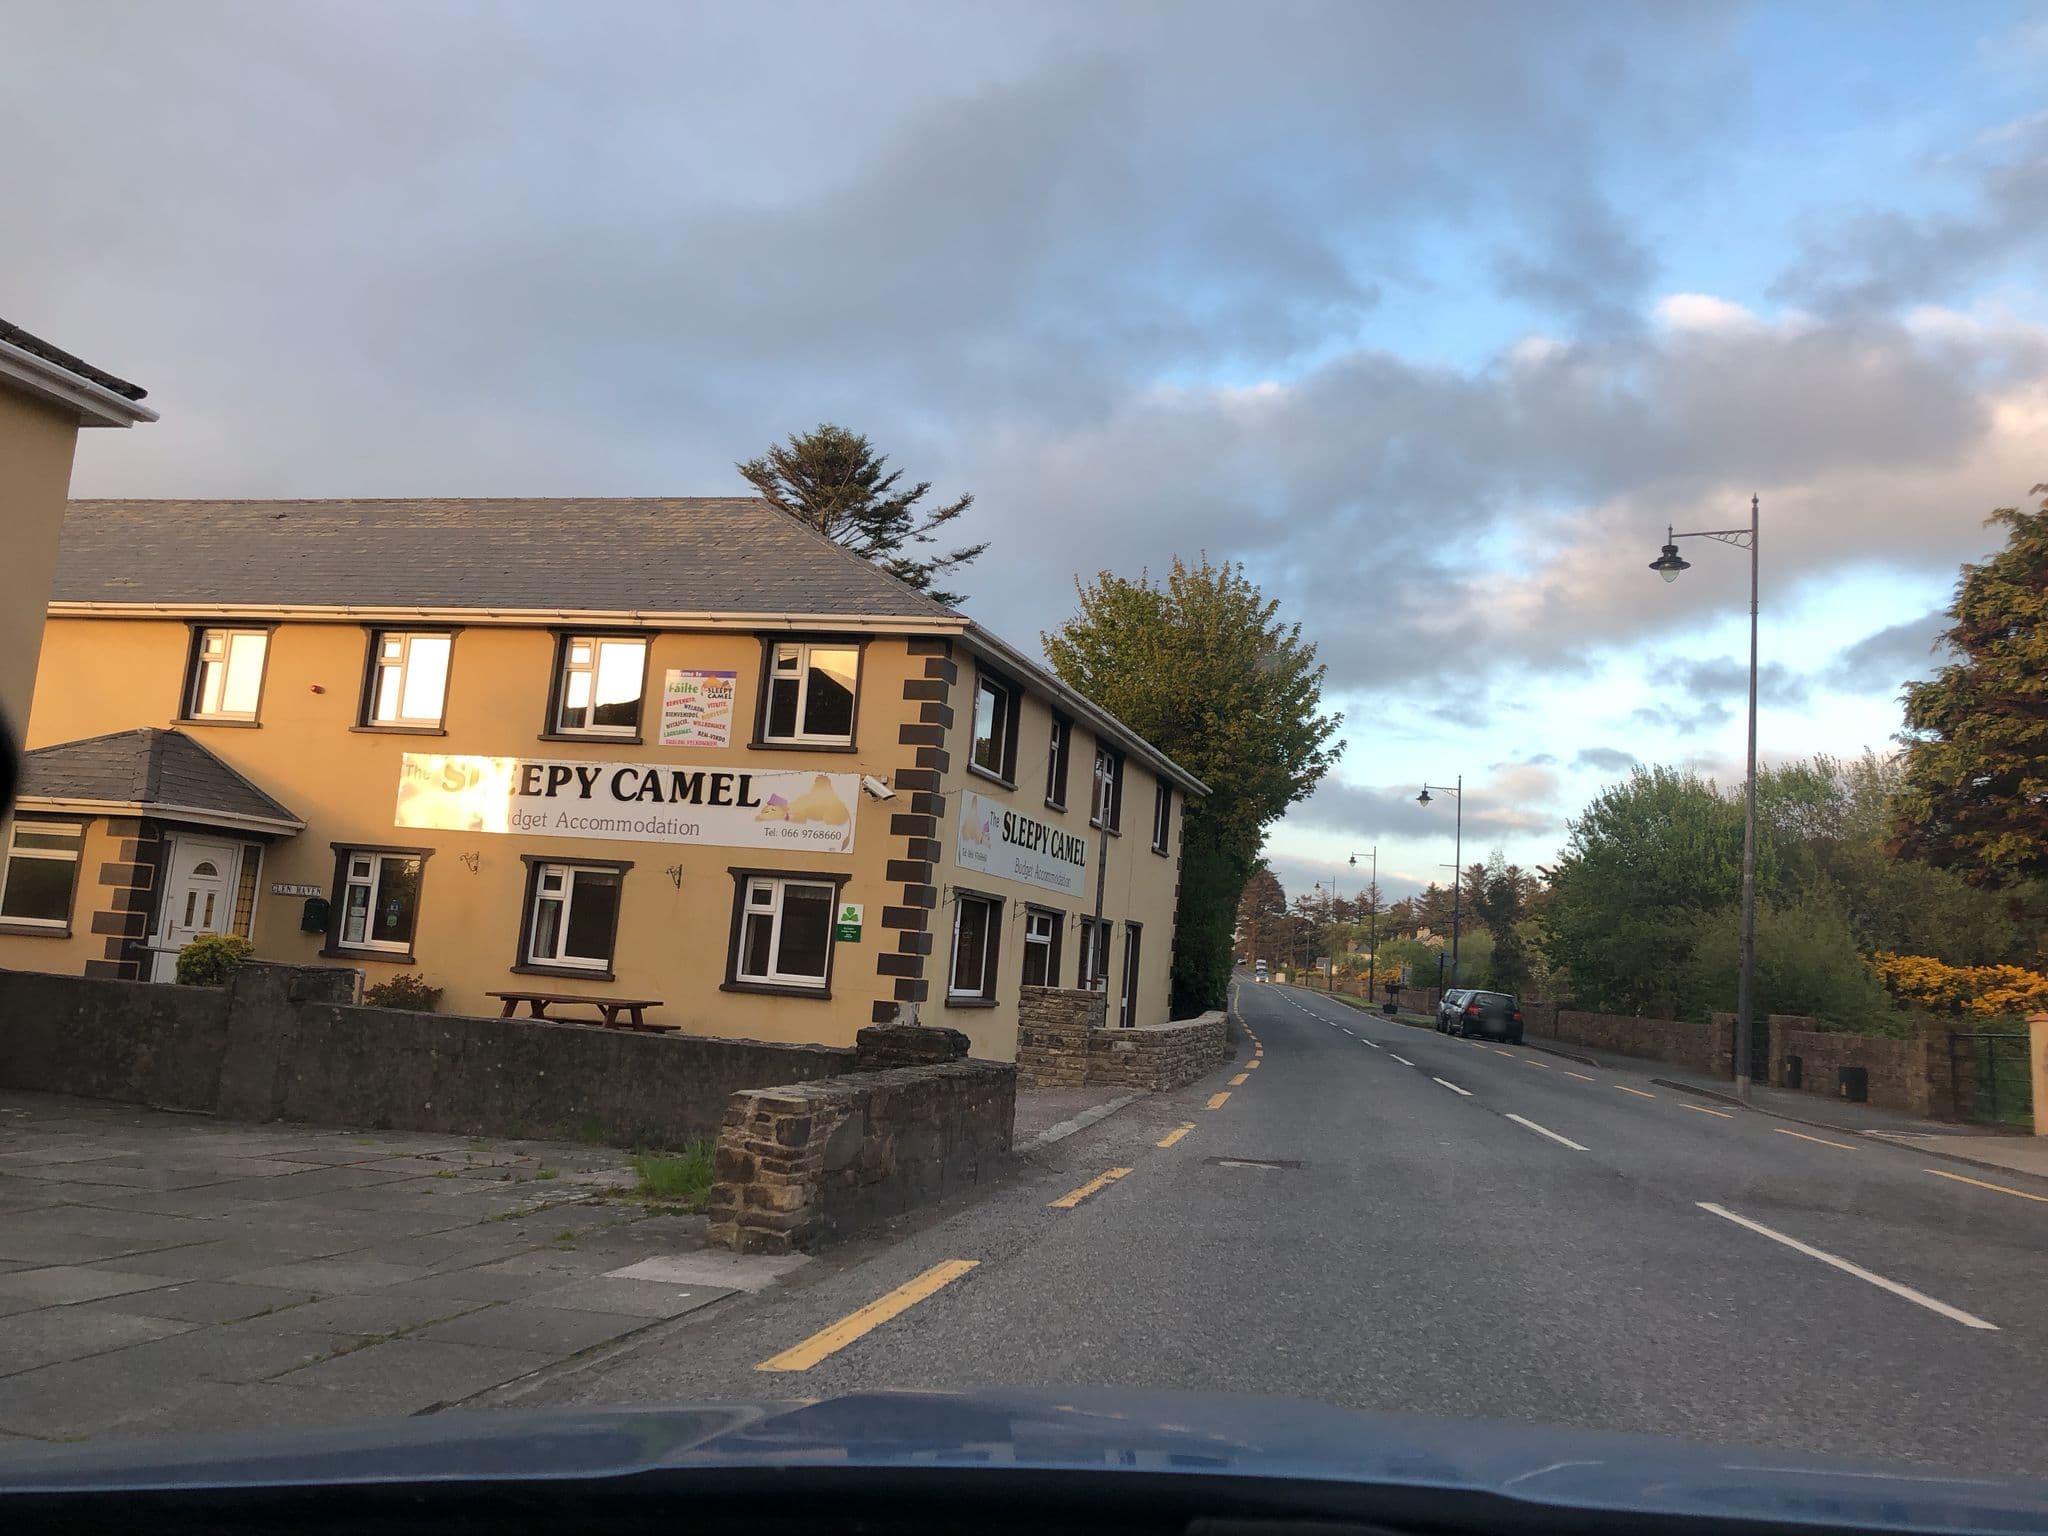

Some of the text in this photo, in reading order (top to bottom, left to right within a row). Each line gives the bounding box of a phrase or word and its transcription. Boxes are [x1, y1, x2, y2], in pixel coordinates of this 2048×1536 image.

[610, 767, 761, 808] CAMEL
[555, 811, 700, 836] Accommodation
[764, 827, 842, 841] Tel: 066 9768660
[990, 811, 1086, 867] The SLEEPY CAMEL
[1014, 857, 1033, 880] Budget
